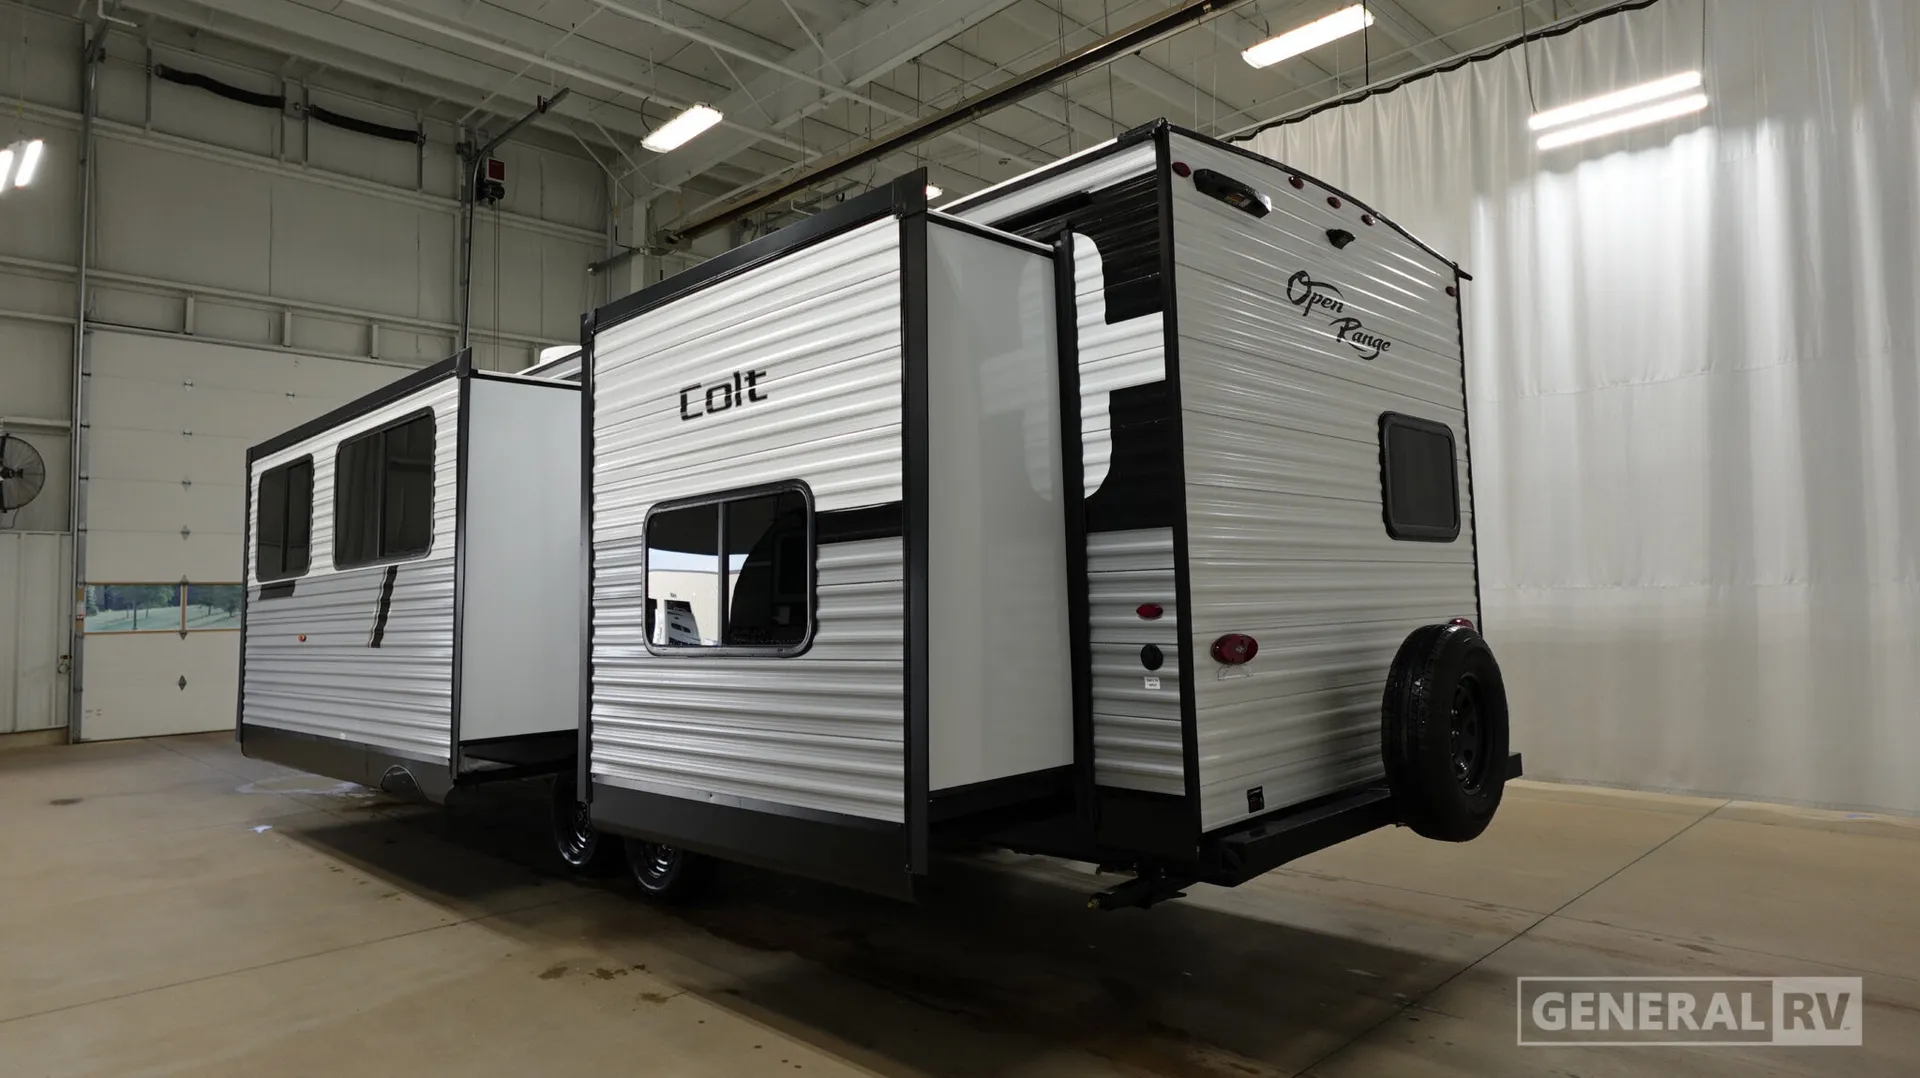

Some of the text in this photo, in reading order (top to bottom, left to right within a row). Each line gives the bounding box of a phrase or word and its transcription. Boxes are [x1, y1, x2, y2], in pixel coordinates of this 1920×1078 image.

[1287, 270, 1345, 316] Open
[1328, 317, 1391, 361] Range
[680, 370, 768, 421] Colt
